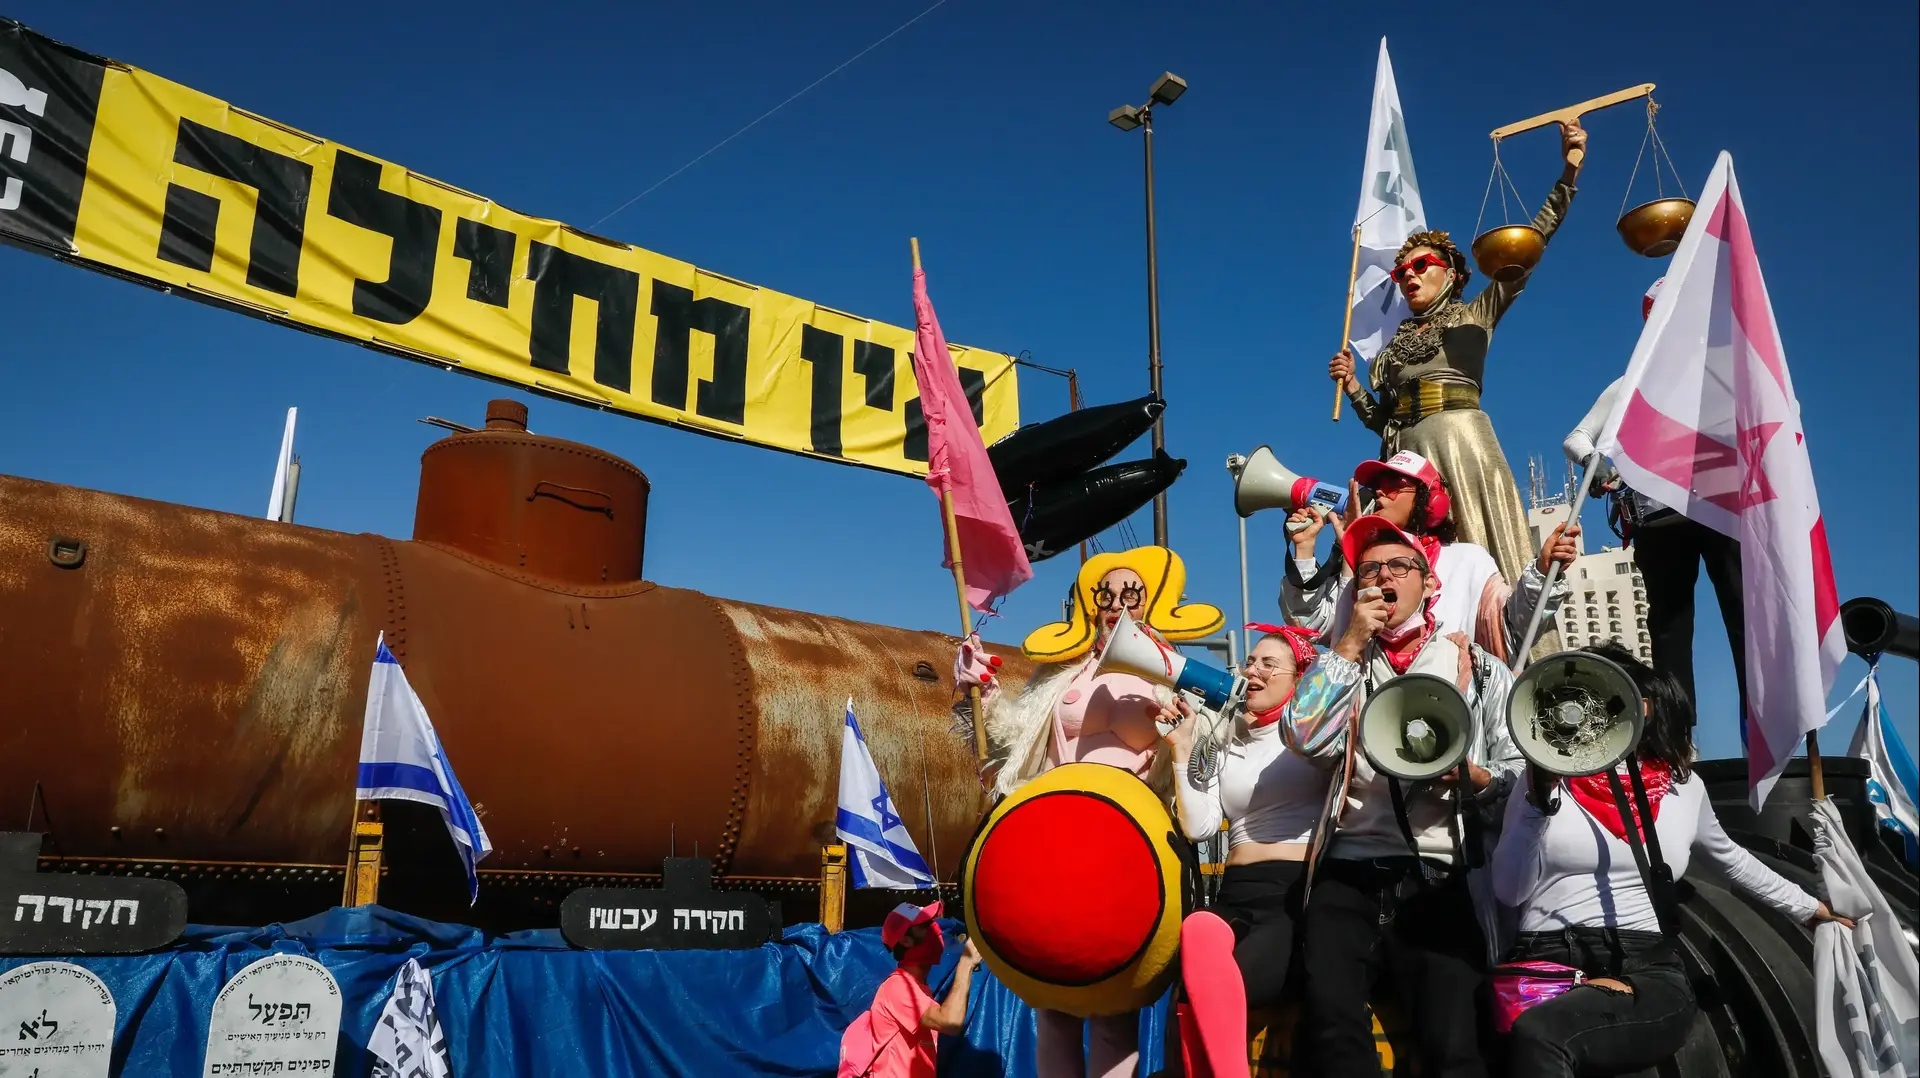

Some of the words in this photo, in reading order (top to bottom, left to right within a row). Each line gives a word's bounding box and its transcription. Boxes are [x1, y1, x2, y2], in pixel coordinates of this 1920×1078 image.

[157, 116, 750, 426] מחילה
[14, 894, 140, 930] חקירה
[589, 907, 658, 931] עכשיו
[673, 908, 744, 934] חקירה
[4, 964, 57, 985] לפוליטיקאי
[60, 967, 95, 985] הדיברות
[248, 956, 293, 976] לפוליטיקאי
[295, 960, 325, 978] הדיברות
[93, 984, 111, 1005] עשרת
[220, 975, 248, 1001] המושחת
[323, 976, 338, 996] עשרת
